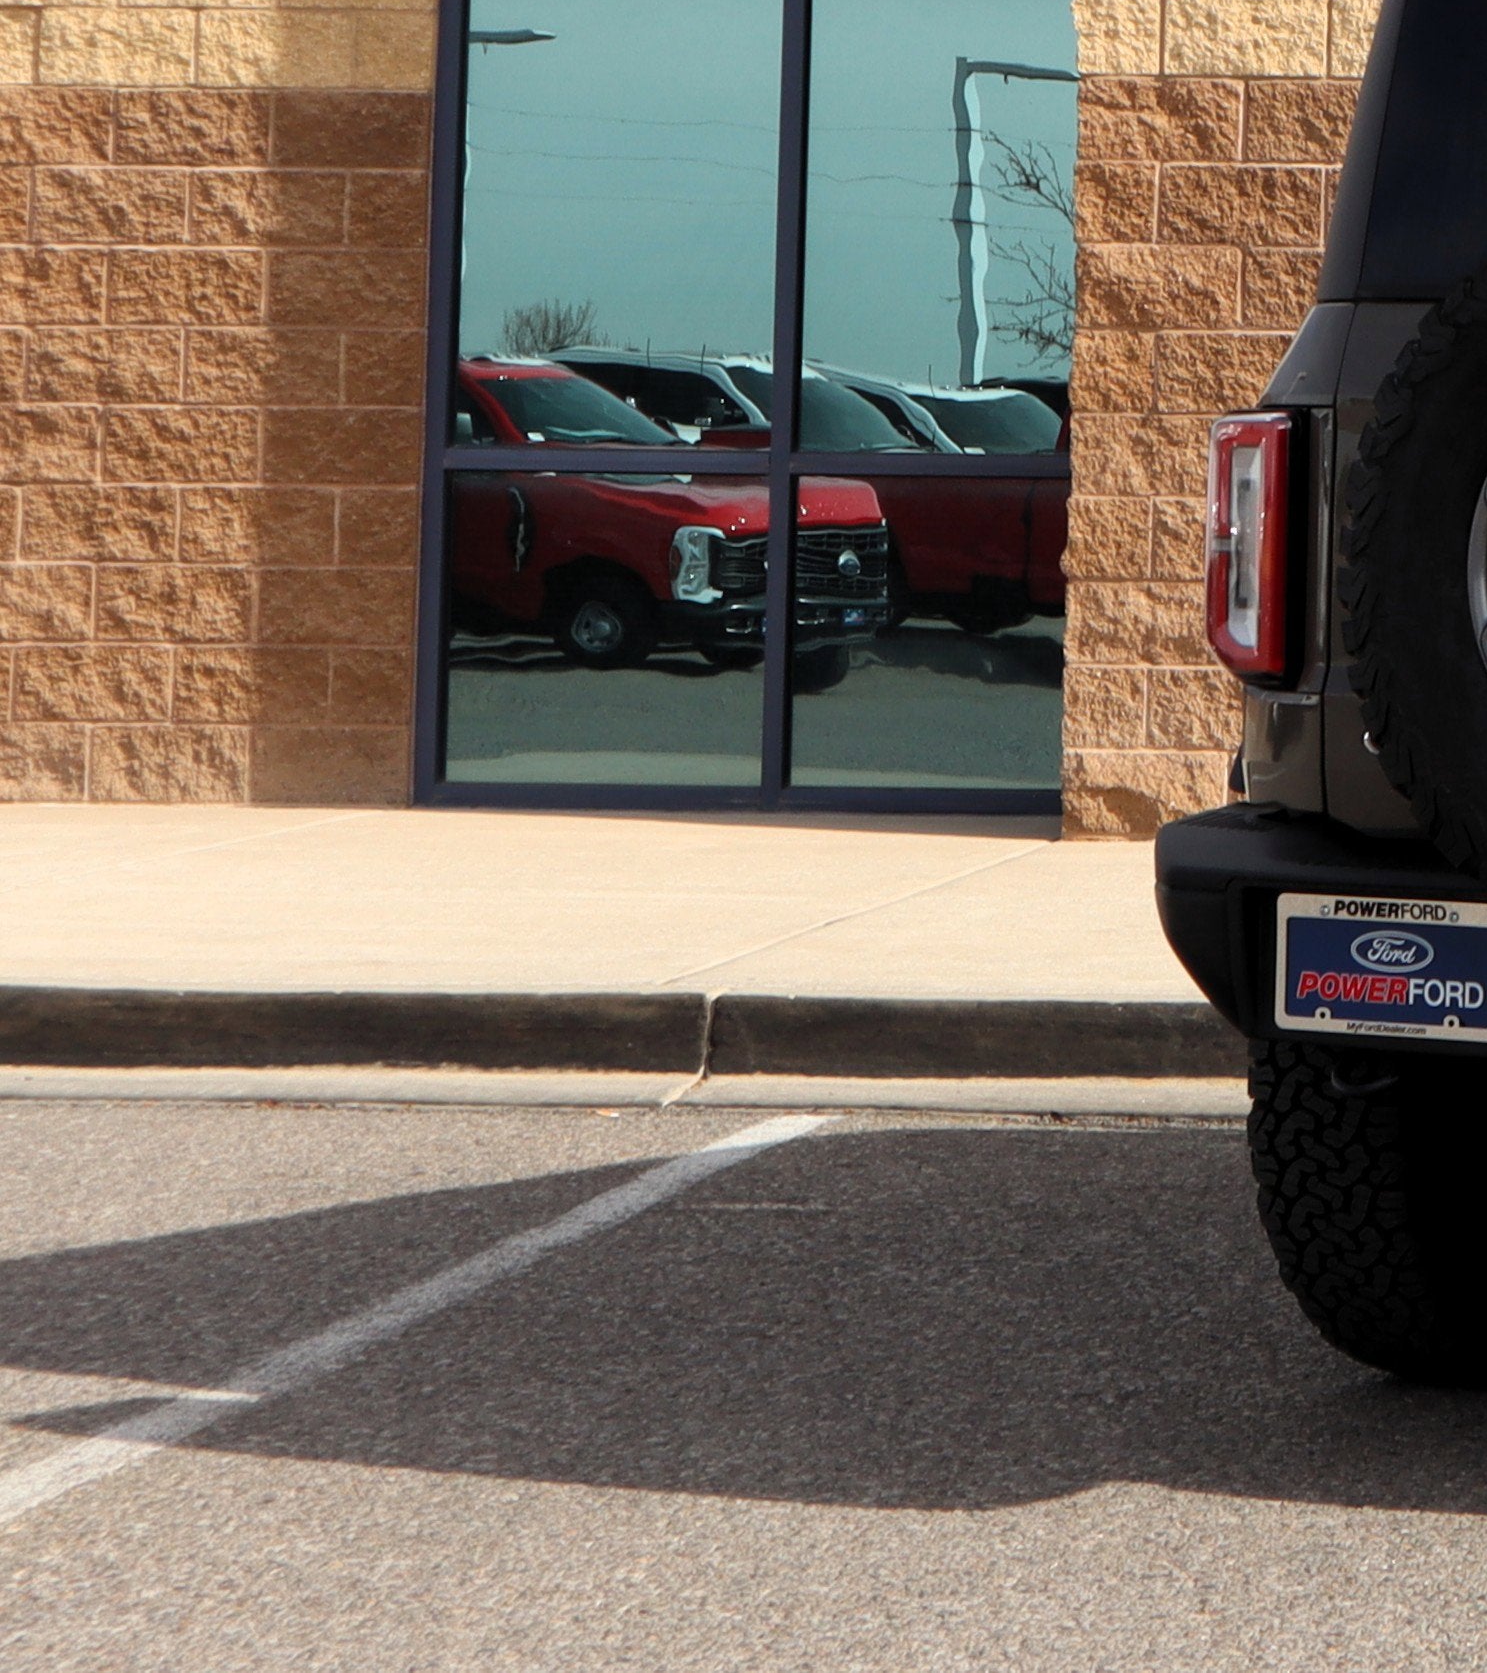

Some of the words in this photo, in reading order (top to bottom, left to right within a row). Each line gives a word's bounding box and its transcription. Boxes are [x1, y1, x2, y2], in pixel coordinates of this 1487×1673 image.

[1333, 899, 1447, 922] POWERFORD
[1367, 936, 1417, 964] Ford
[1297, 971, 1485, 1010] POWERFORD
[1346, 1022, 1427, 1035] MyFordDealer.com
